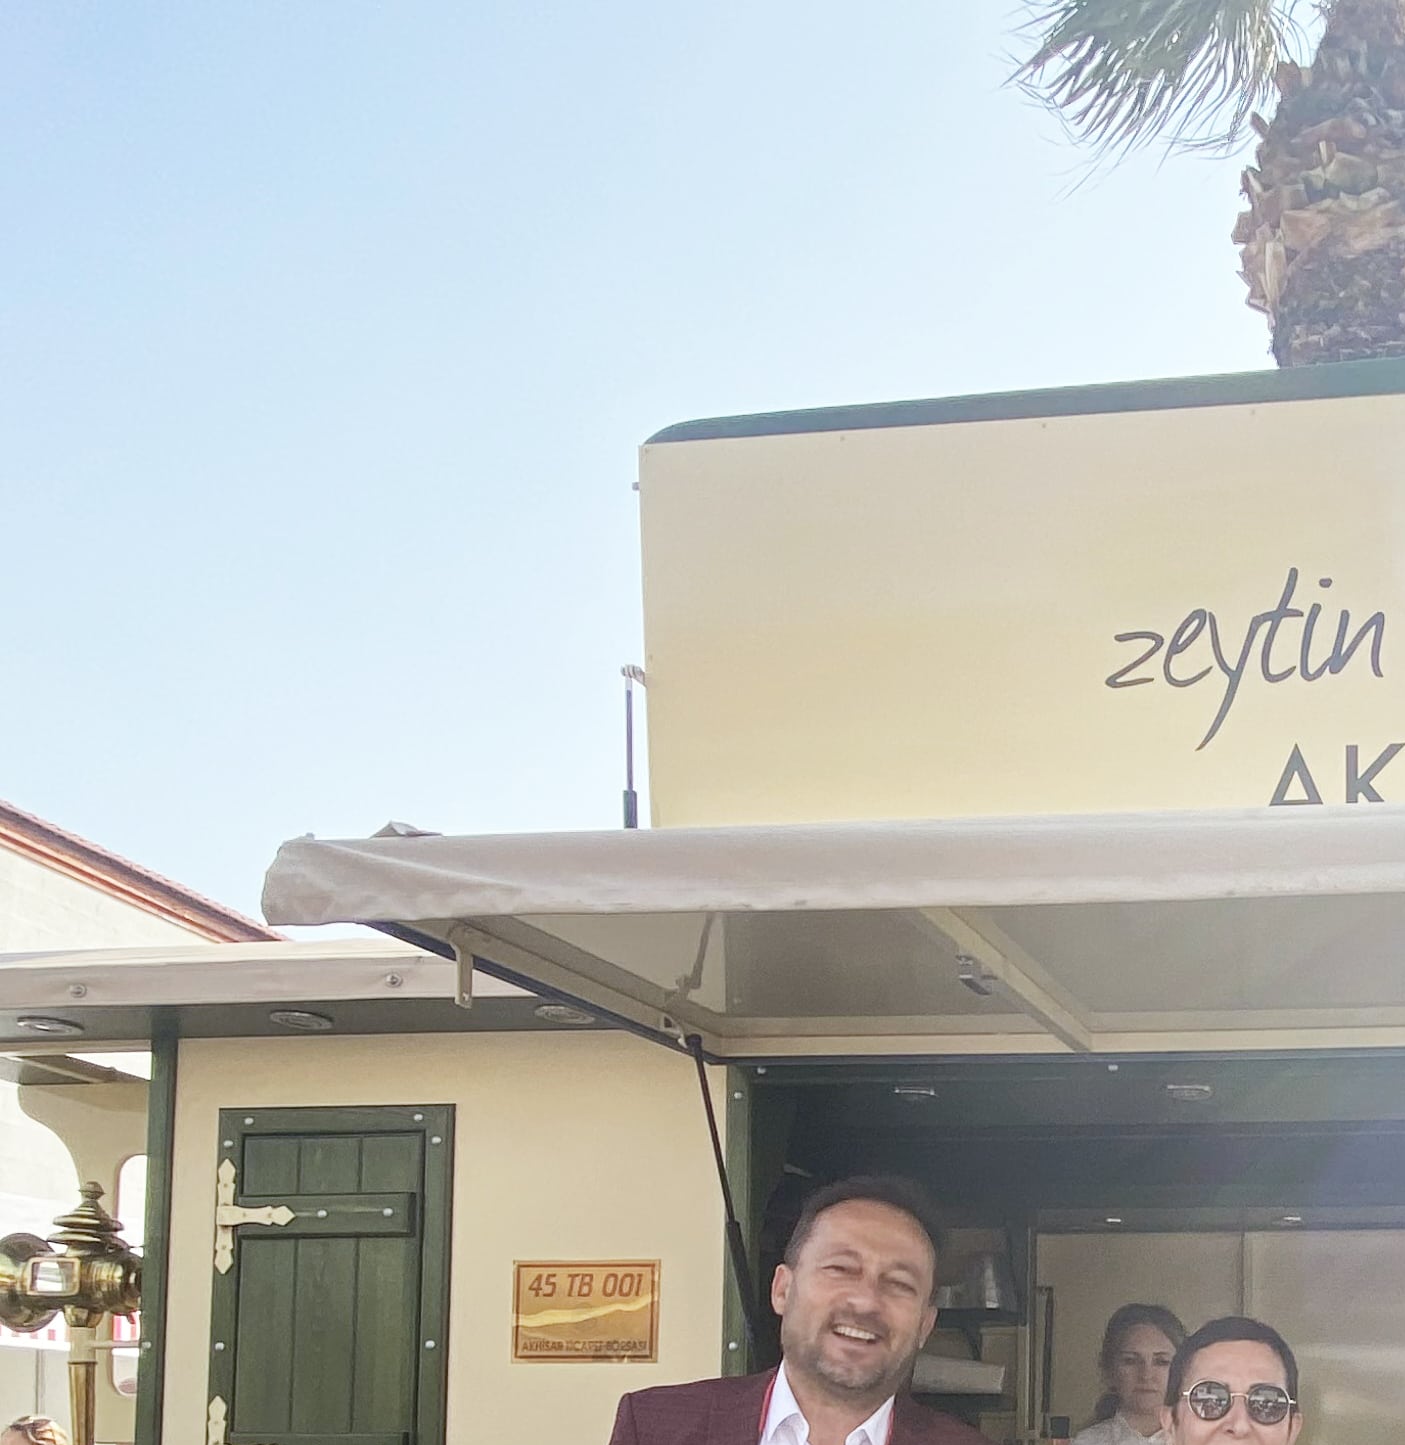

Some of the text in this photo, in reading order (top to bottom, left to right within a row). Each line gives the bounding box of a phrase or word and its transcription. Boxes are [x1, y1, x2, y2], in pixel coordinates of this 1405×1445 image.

[1105, 566, 1387, 751] zeytin
[528, 1273, 643, 1297] 45 TB 001
